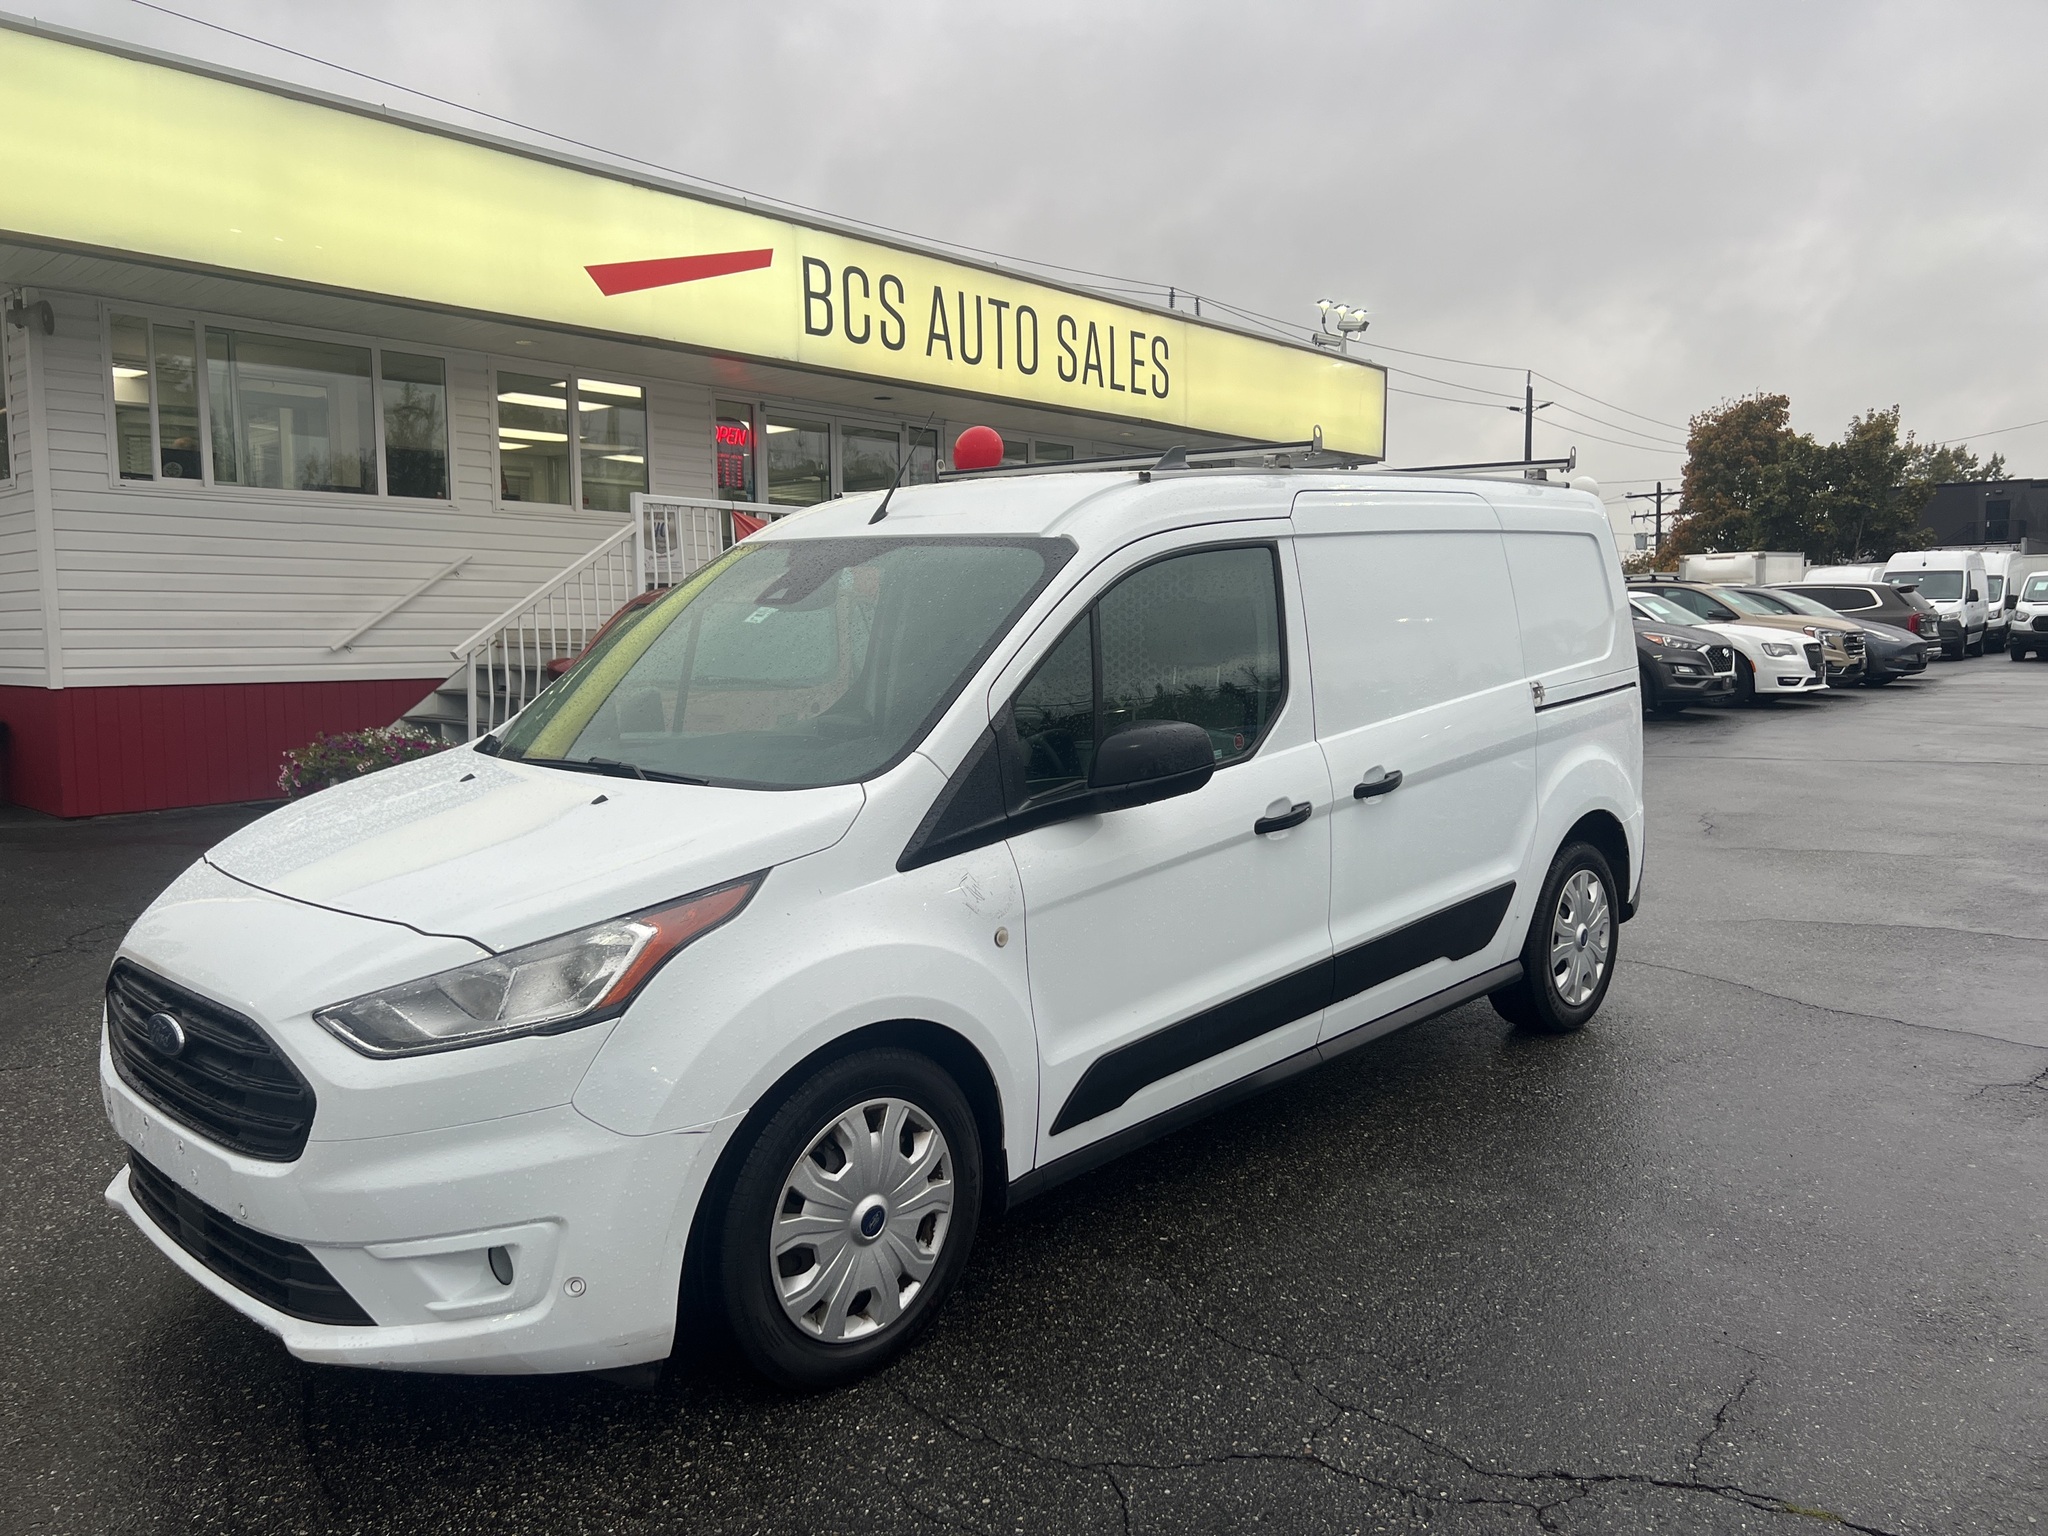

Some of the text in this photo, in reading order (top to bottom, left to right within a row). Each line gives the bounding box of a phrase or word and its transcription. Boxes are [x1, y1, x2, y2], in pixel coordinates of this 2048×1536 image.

[802, 255, 1169, 399] BCS AUTO SALES
